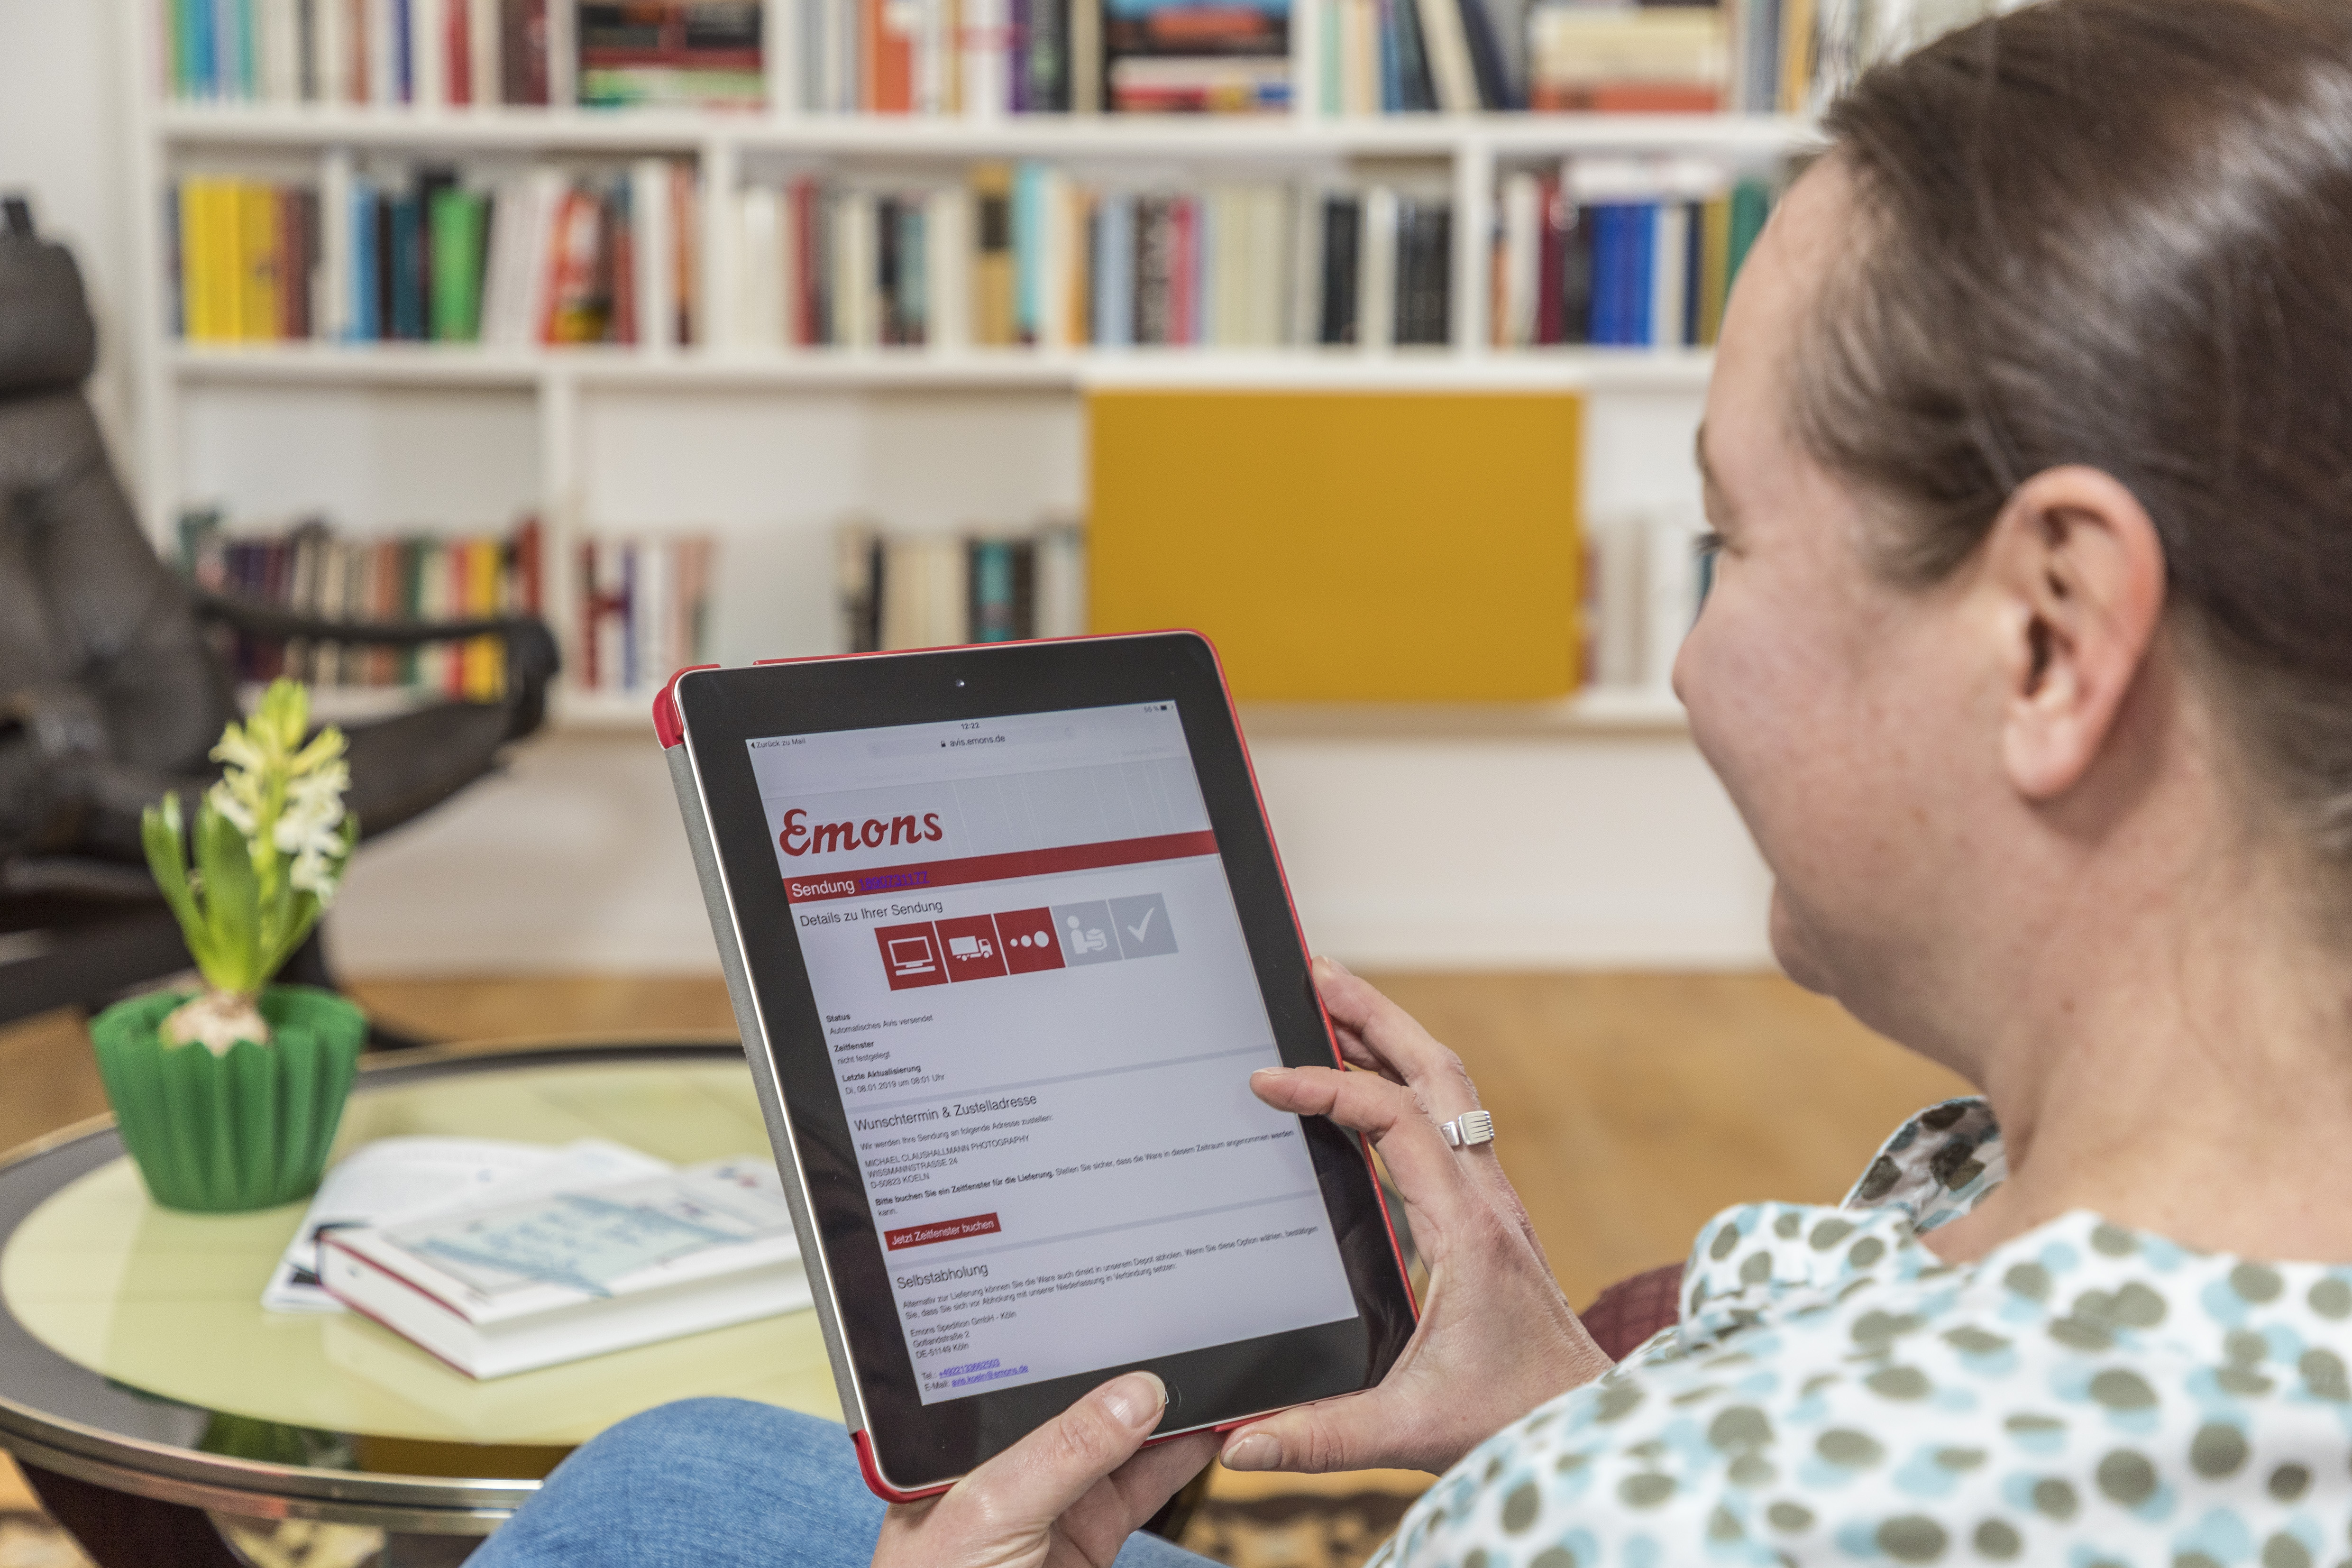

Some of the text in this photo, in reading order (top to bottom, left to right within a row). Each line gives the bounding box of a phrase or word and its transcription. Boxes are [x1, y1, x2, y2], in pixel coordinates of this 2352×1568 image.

[756, 740, 780, 748] Zurück
[950, 734, 1005, 747] avis.emons.de
[779, 808, 943, 856] Emons
[791, 880, 855, 897] Sendung
[799, 901, 943, 926] Details zu Ihrer Sendung
[825, 1014, 851, 1022] Status
[830, 1022, 881, 1035] Automatisches
[898, 1014, 933, 1025] versendet
[833, 1041, 874, 1052] Zeitfenster
[837, 1051, 890, 1064] nicht festgelegt
[842, 1065, 921, 1082] Letzte Aktualisierung
[931, 1073, 944, 1082] Uhr
[853, 1095, 1037, 1131] Wunschtermin & Zustelladresse
[860, 1142, 872, 1150] Wir
[874, 1139, 900, 1148] werden
[917, 1131, 949, 1141] Sendung
[960, 1124, 990, 1135] folgende
[992, 1120, 1020, 1129] Adresse
[864, 1155, 900, 1167] MICHAEL
[970, 1134, 1029, 1150] PHOTOGRAPHY
[948, 1157, 958, 1165] 24
[875, 1197, 893, 1206] Bitte
[894, 1192, 923, 1202] buchen
[924, 1190, 937, 1198] Sie
[938, 1187, 950, 1195] ein
[951, 1181, 990, 1193] Zeitfenster
[1055, 1166, 1079, 1175] Stellen
[1171, 1147, 1195, 1156] diesem
[1196, 1142, 1224, 1152] Zeitraum
[1271, 1130, 1293, 1139] werden
[902, 1172, 930, 1183] KOELN
[891, 1220, 994, 1245] Jetzt Zeitfenster buchen
[897, 1264, 988, 1289] Selbstabholung
[903, 1297, 935, 1309] Alternativ
[937, 1294, 948, 1302] zur
[950, 1288, 983, 1300] Lieferung
[984, 1284, 1010, 1293] können
[1011, 1280, 1023, 1288] Sie
[1036, 1275, 1055, 1284] Ware
[1057, 1271, 1074, 1280] auch
[1075, 1267, 1094, 1276] direkt
[1103, 1260, 1133, 1271] unserem
[1133, 1256, 1154, 1266] Depot
[1184, 1247, 1204, 1256] Wenn
[1205, 1244, 1216, 1252] Sie
[1217, 1241, 1235, 1250] diese
[1236, 1237, 1258, 1247] Option
[921, 1308, 938, 1317] dass
[939, 1305, 952, 1313] Sie
[953, 1302, 968, 1311] sich
[982, 1293, 1016, 1305] Abholung
[1016, 1290, 1027, 1298] mit
[1028, 1286, 1054, 1296] unserer
[1055, 1277, 1105, 1291] Niederlassung
[1113, 1268, 1152, 1280] Verbindung
[909, 1327, 935, 1337] Emons
[936, 1320, 970, 1332] Spedition
[970, 1314, 994, 1325] GmbH
[1000, 1311, 1016, 1319] Köln
[912, 1330, 970, 1348] Gotlandstraße 2
